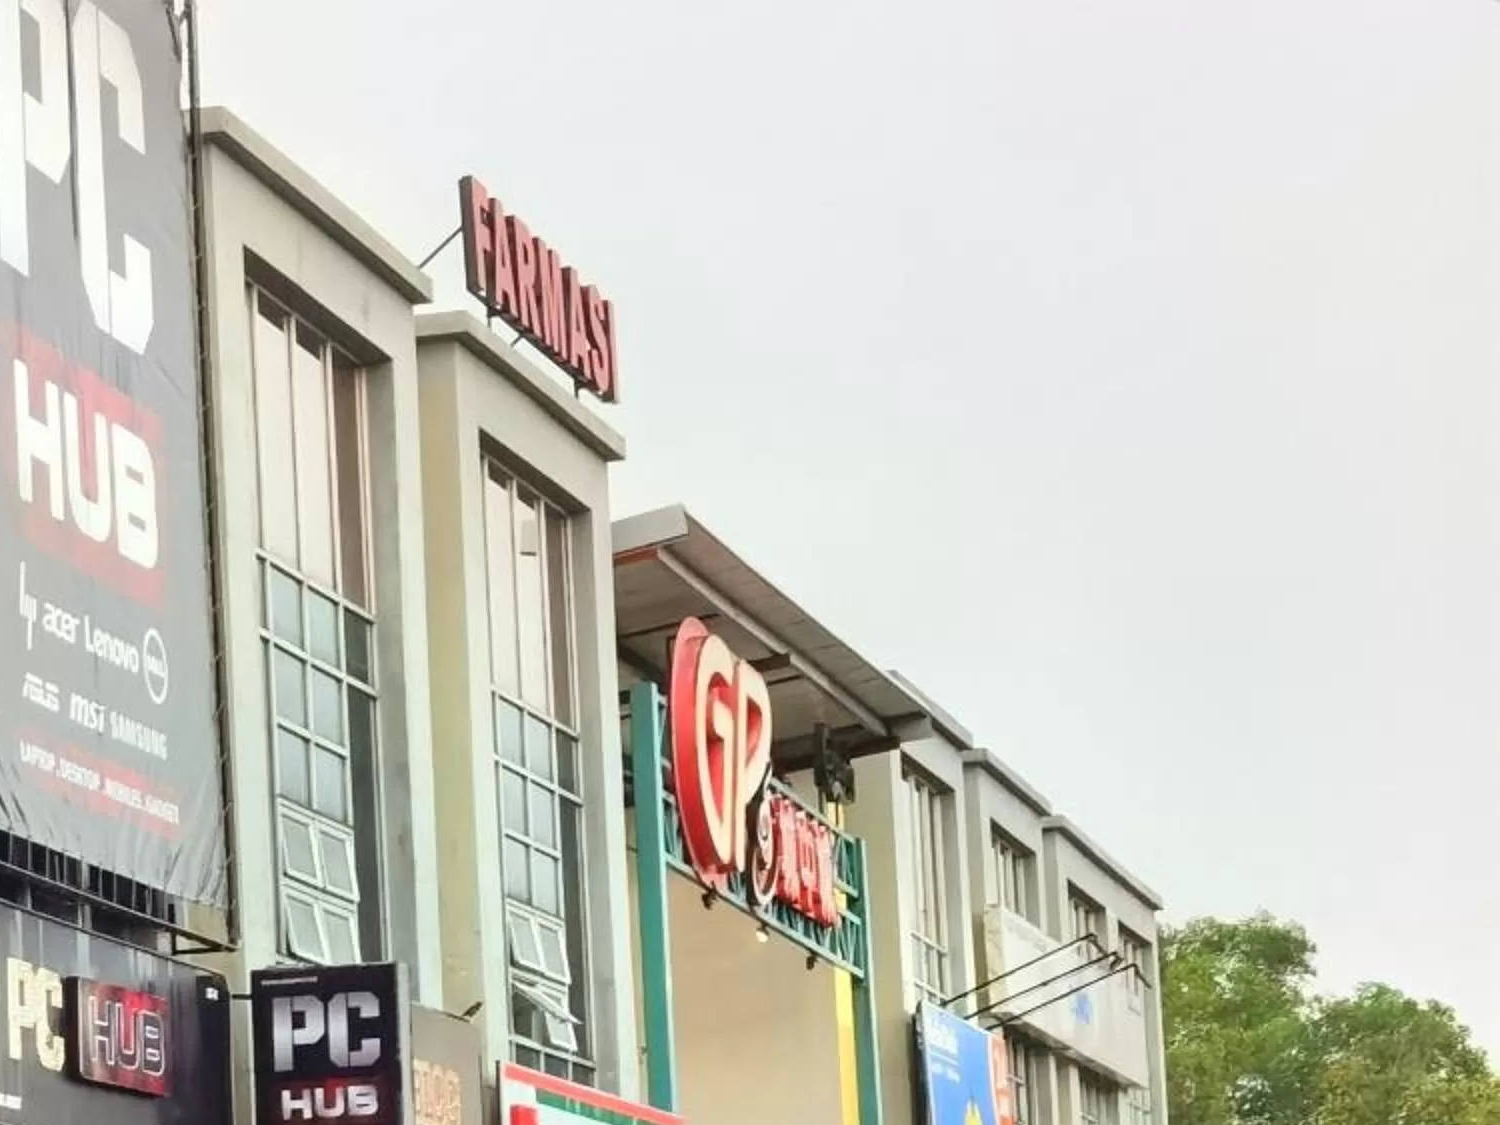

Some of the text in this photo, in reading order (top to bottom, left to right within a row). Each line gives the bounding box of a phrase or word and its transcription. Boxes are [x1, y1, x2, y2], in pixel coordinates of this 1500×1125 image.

[460, 176, 619, 404] FARMASI
[14, 358, 159, 569] HUB
[43, 602, 80, 644] acer
[84, 615, 140, 673] Lenovo
[7, 957, 166, 1078] PC HUB
[272, 991, 381, 1073] PC
[281, 1083, 380, 1121] HUB
